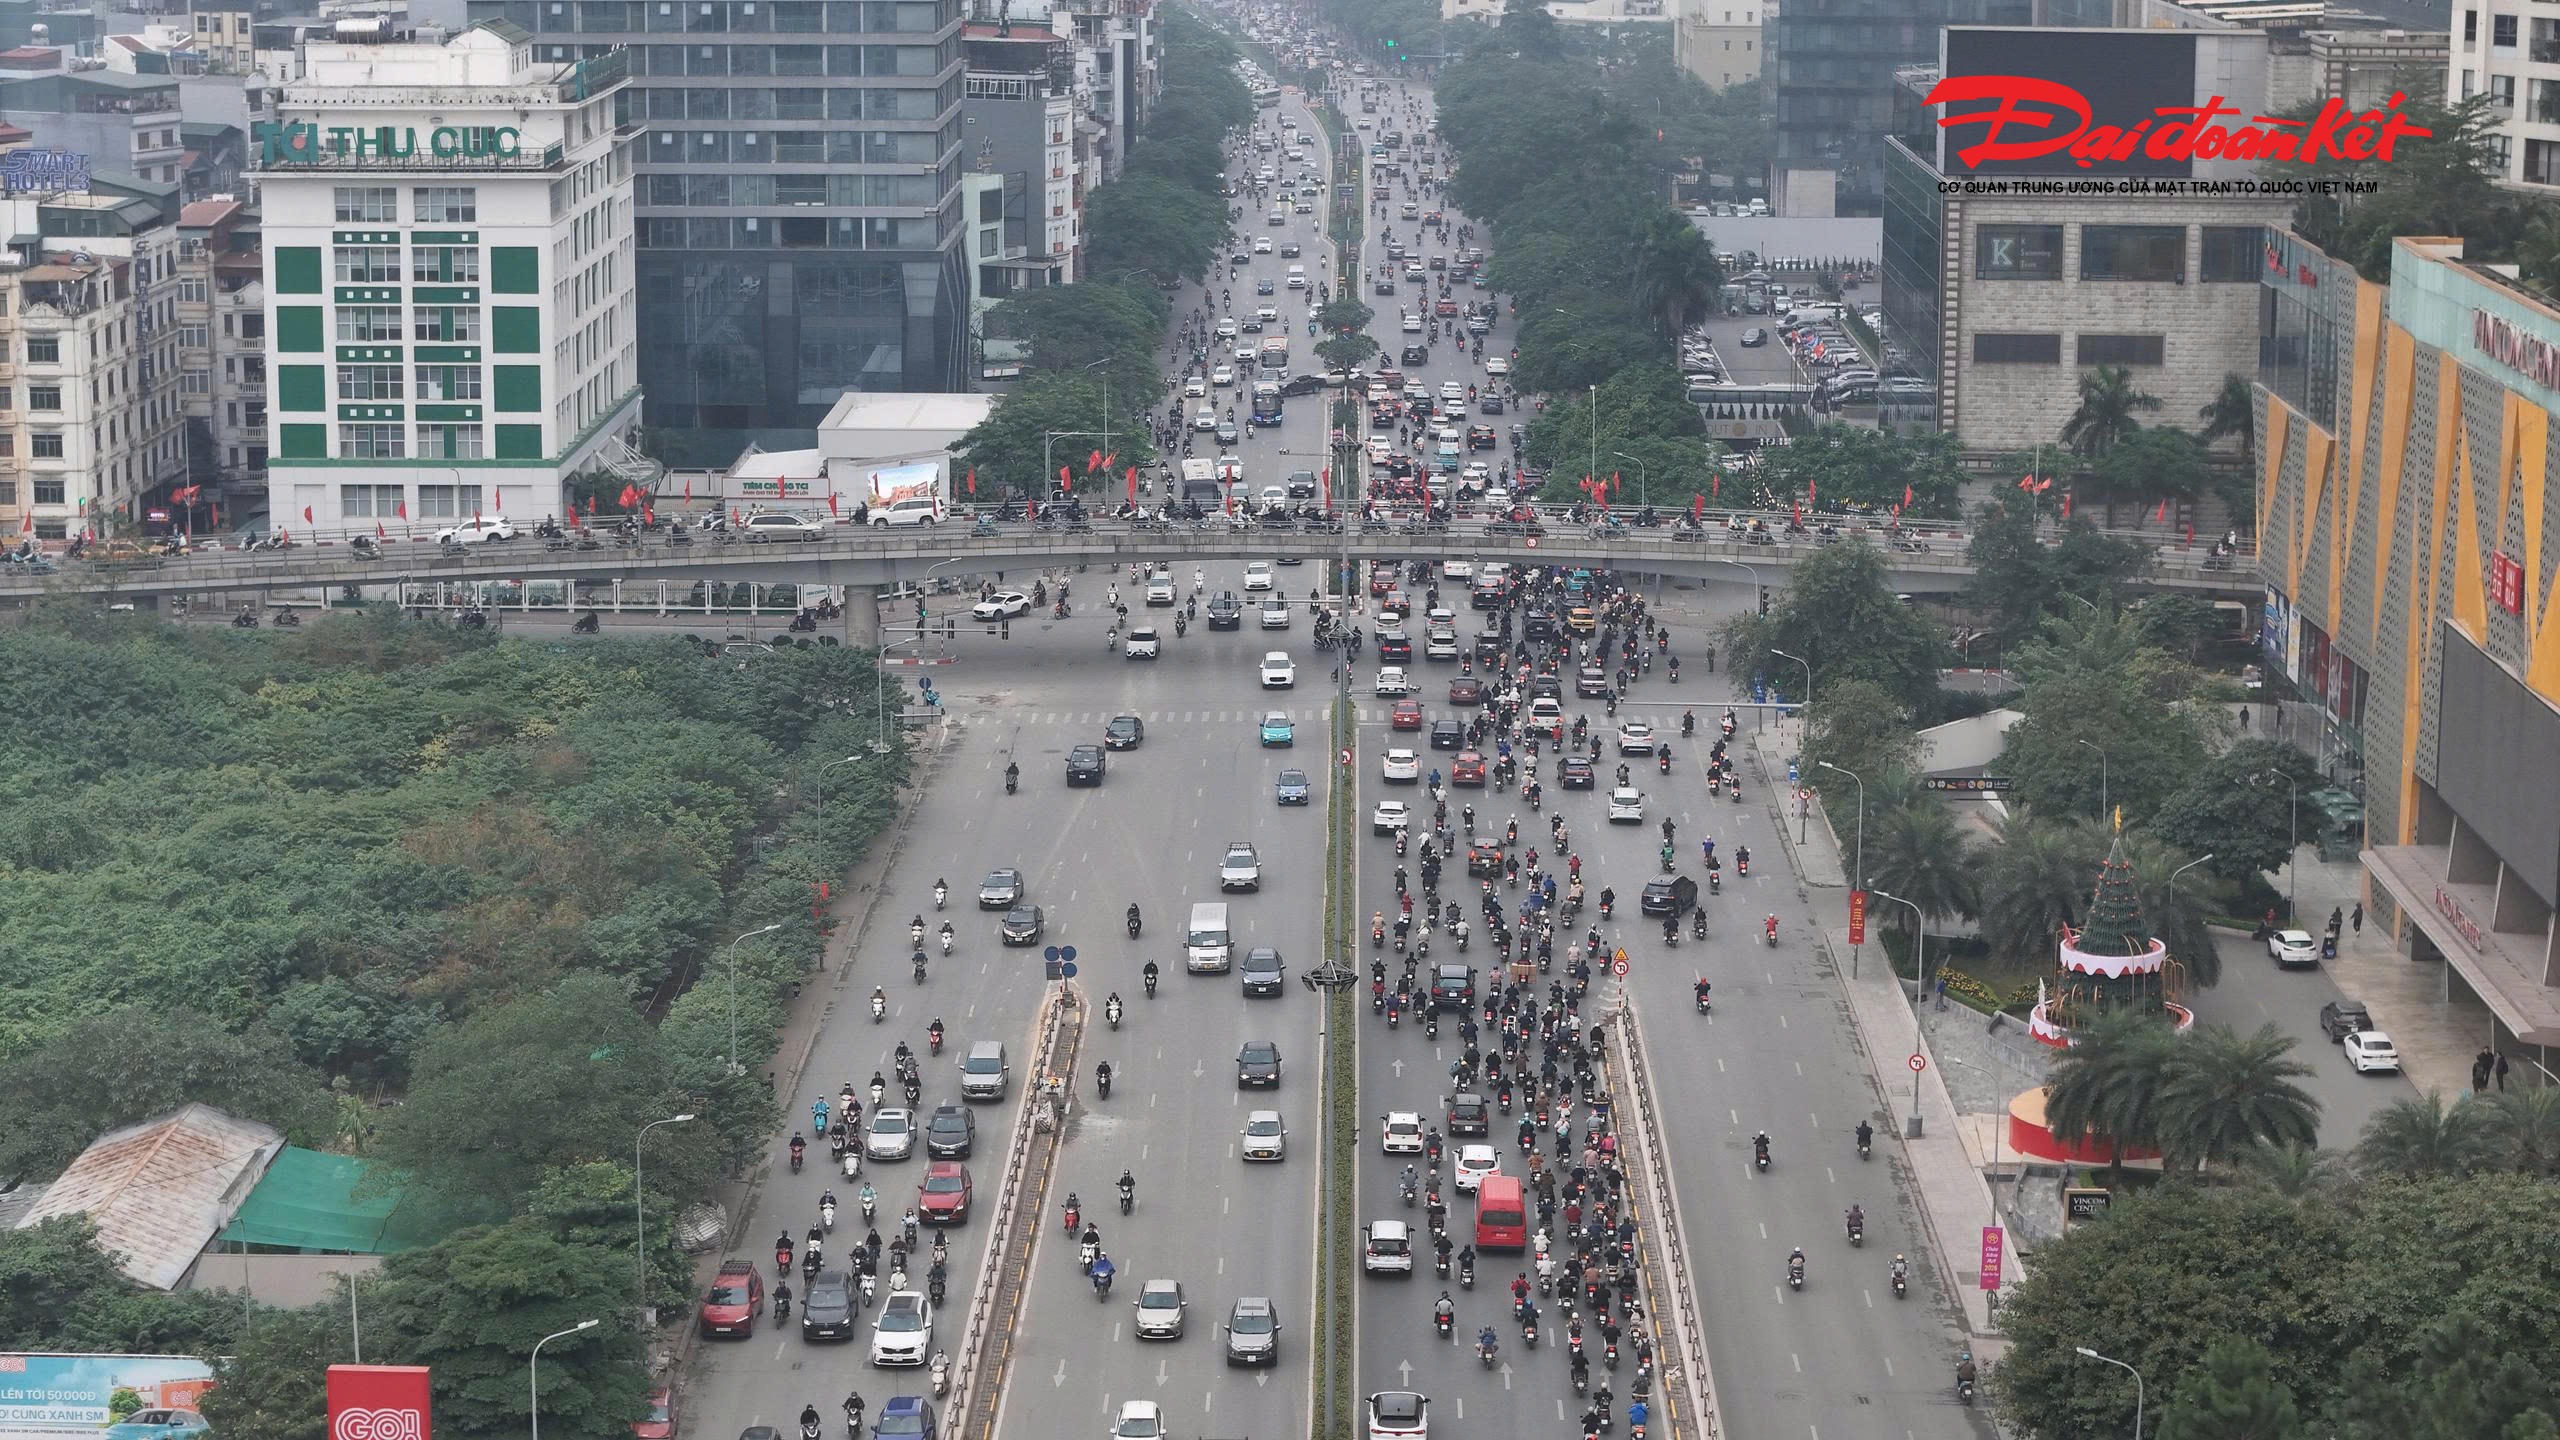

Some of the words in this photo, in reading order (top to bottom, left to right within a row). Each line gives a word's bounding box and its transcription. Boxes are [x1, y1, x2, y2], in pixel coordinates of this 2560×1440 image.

[328, 127, 414, 158] THU
[3, 149, 88, 172] SMART
[1992, 239, 2014, 265] K
[1, 1387, 23, 1399] LÊN
[26, 1388, 45, 1400] TỚI
[47, 1390, 96, 1401] 50.000Đ
[48, 1410, 83, 1421] XANH
[86, 1411, 104, 1421] SM
[335, 1407, 422, 1440] GO!
